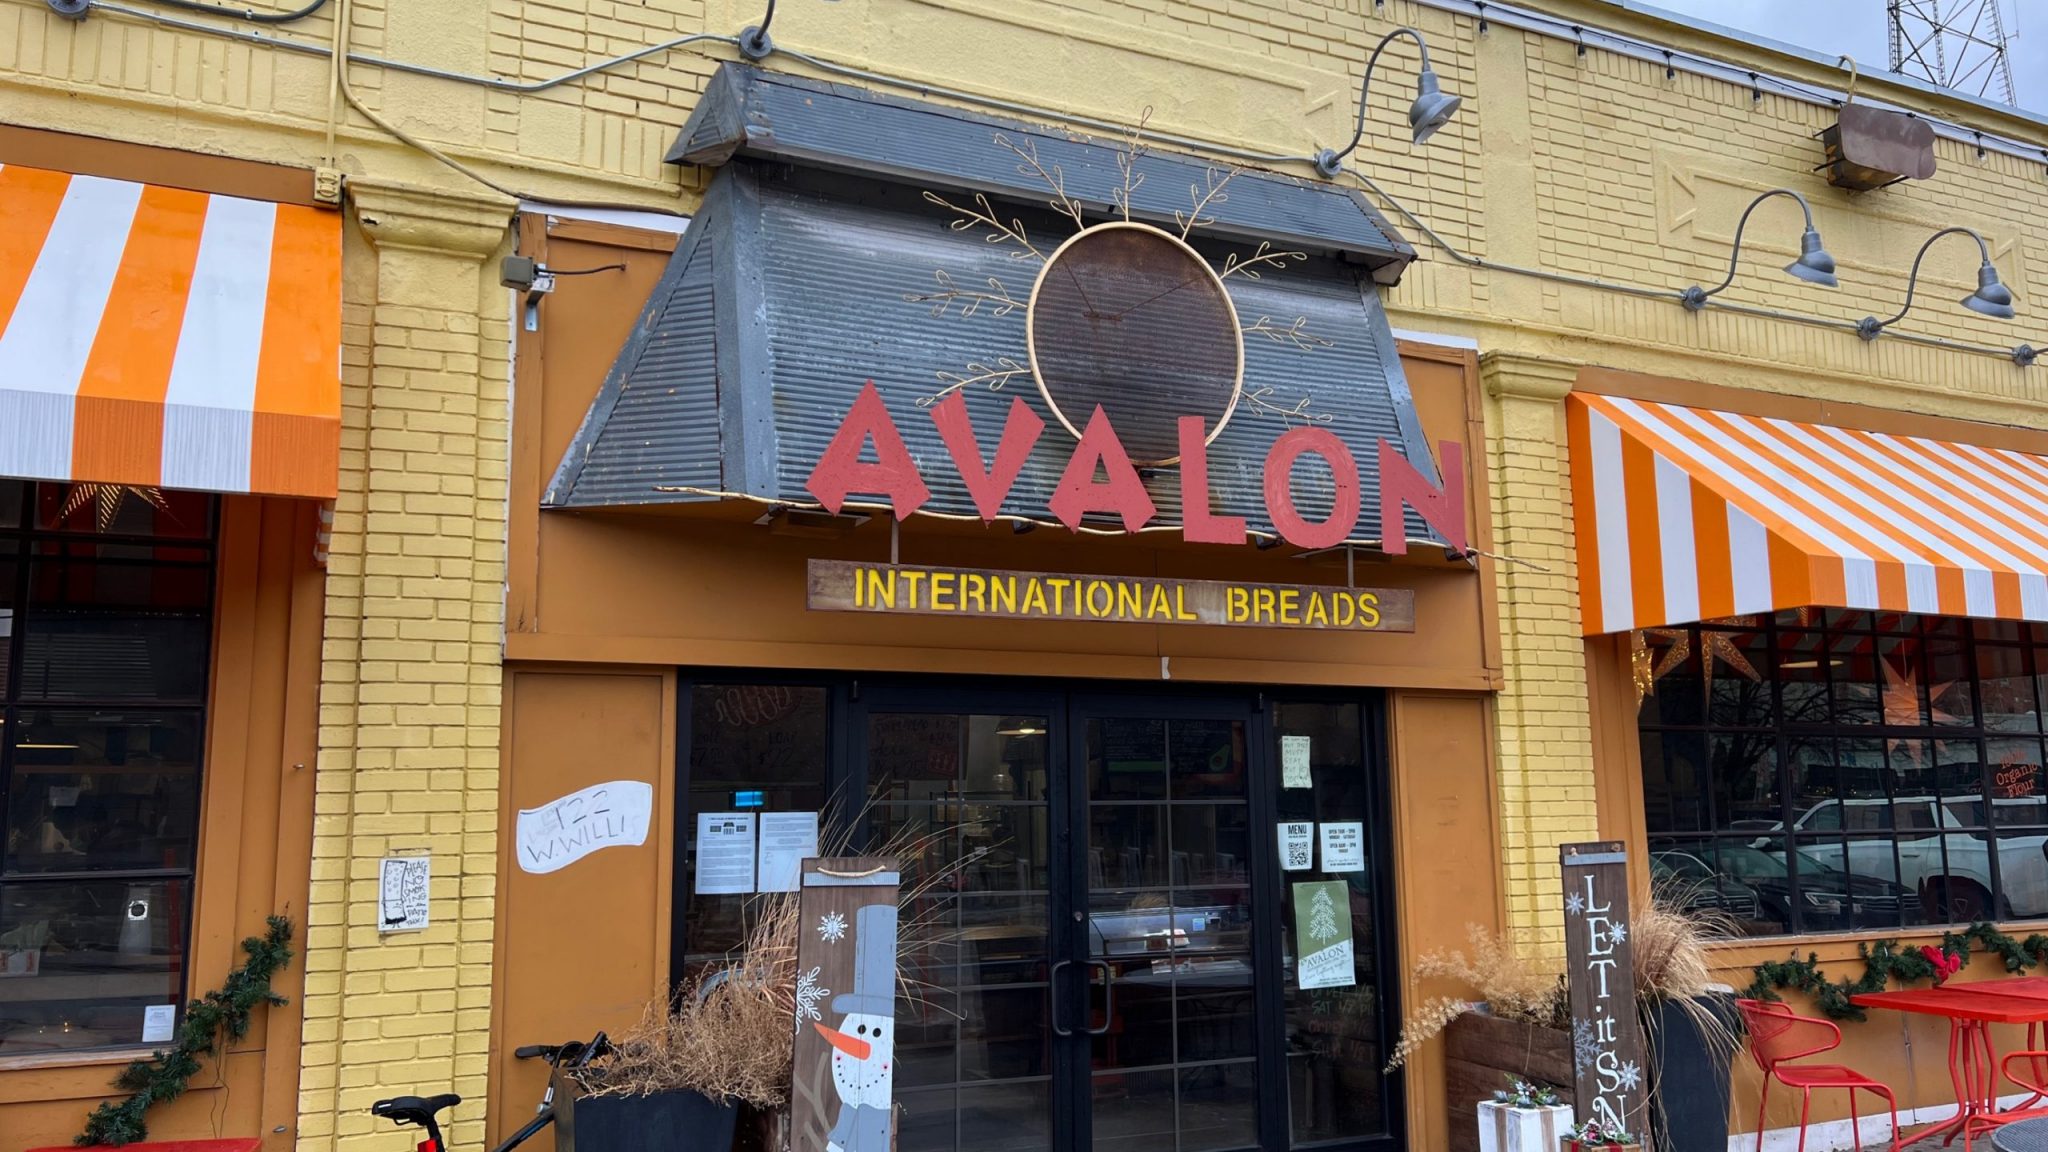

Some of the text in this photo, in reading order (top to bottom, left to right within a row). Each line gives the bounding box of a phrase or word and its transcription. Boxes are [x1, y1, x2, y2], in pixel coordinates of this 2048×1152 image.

[804, 379, 1467, 556] AVALON
[854, 567, 1381, 628] INTERNATIONAL BREADS
[1996, 761, 2038, 786] Organic
[2006, 779, 2034, 798] Flour
[1287, 824, 1307, 835] MENU
[405, 875, 424, 888] NO
[1583, 874, 1617, 999] LET
[1307, 945, 1345, 969] AVALON
[1595, 1005, 1617, 1043] it
